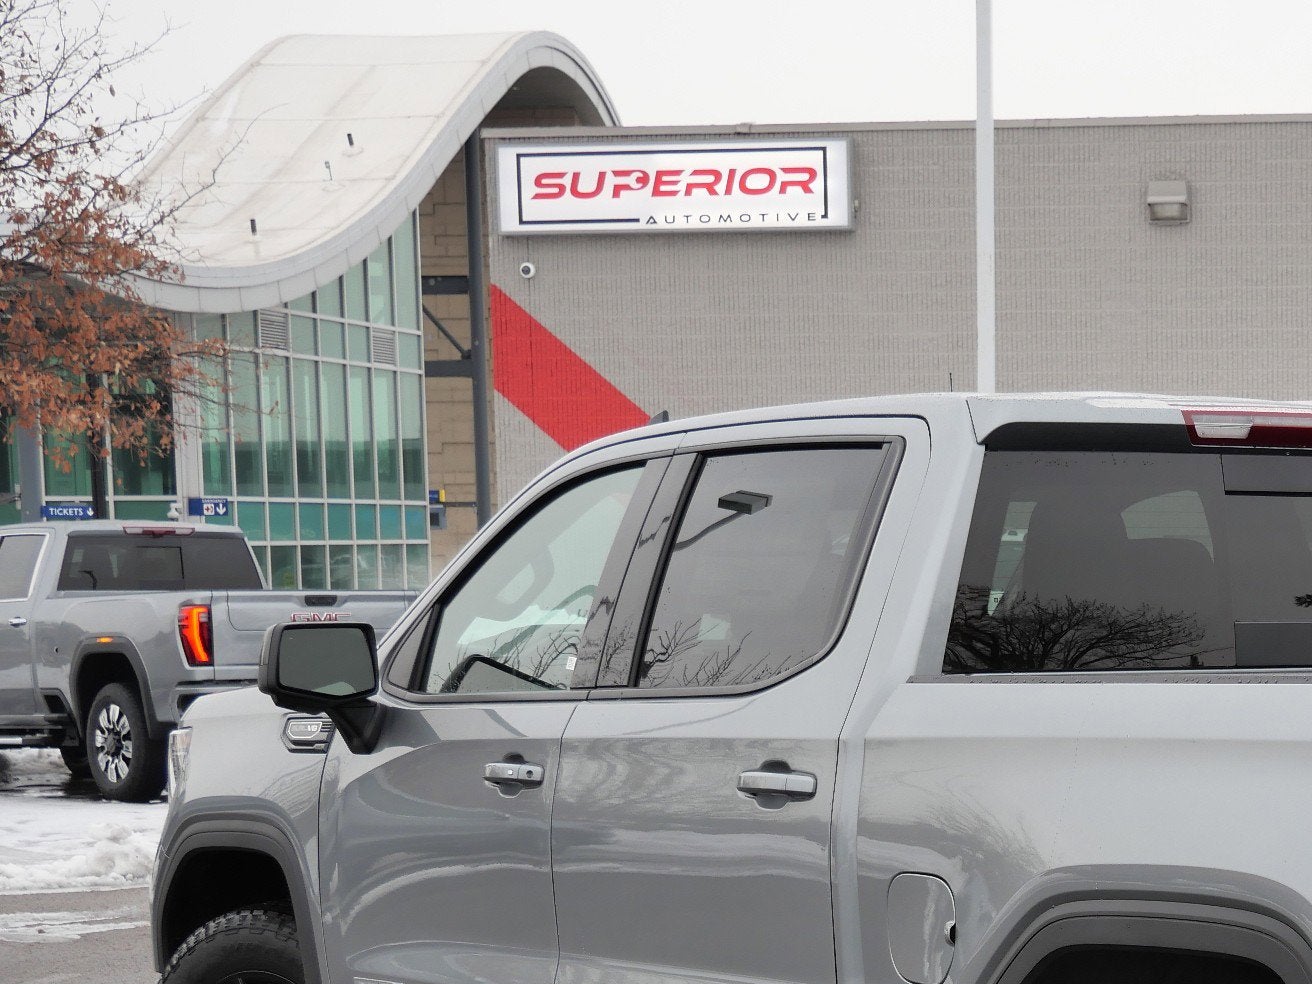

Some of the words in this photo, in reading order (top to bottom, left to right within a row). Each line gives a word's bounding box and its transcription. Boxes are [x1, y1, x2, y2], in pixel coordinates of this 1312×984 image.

[531, 167, 818, 200] SUPERIOR
[645, 212, 817, 225] AUTOMOTIVE
[49, 507, 83, 517] TICKETS
